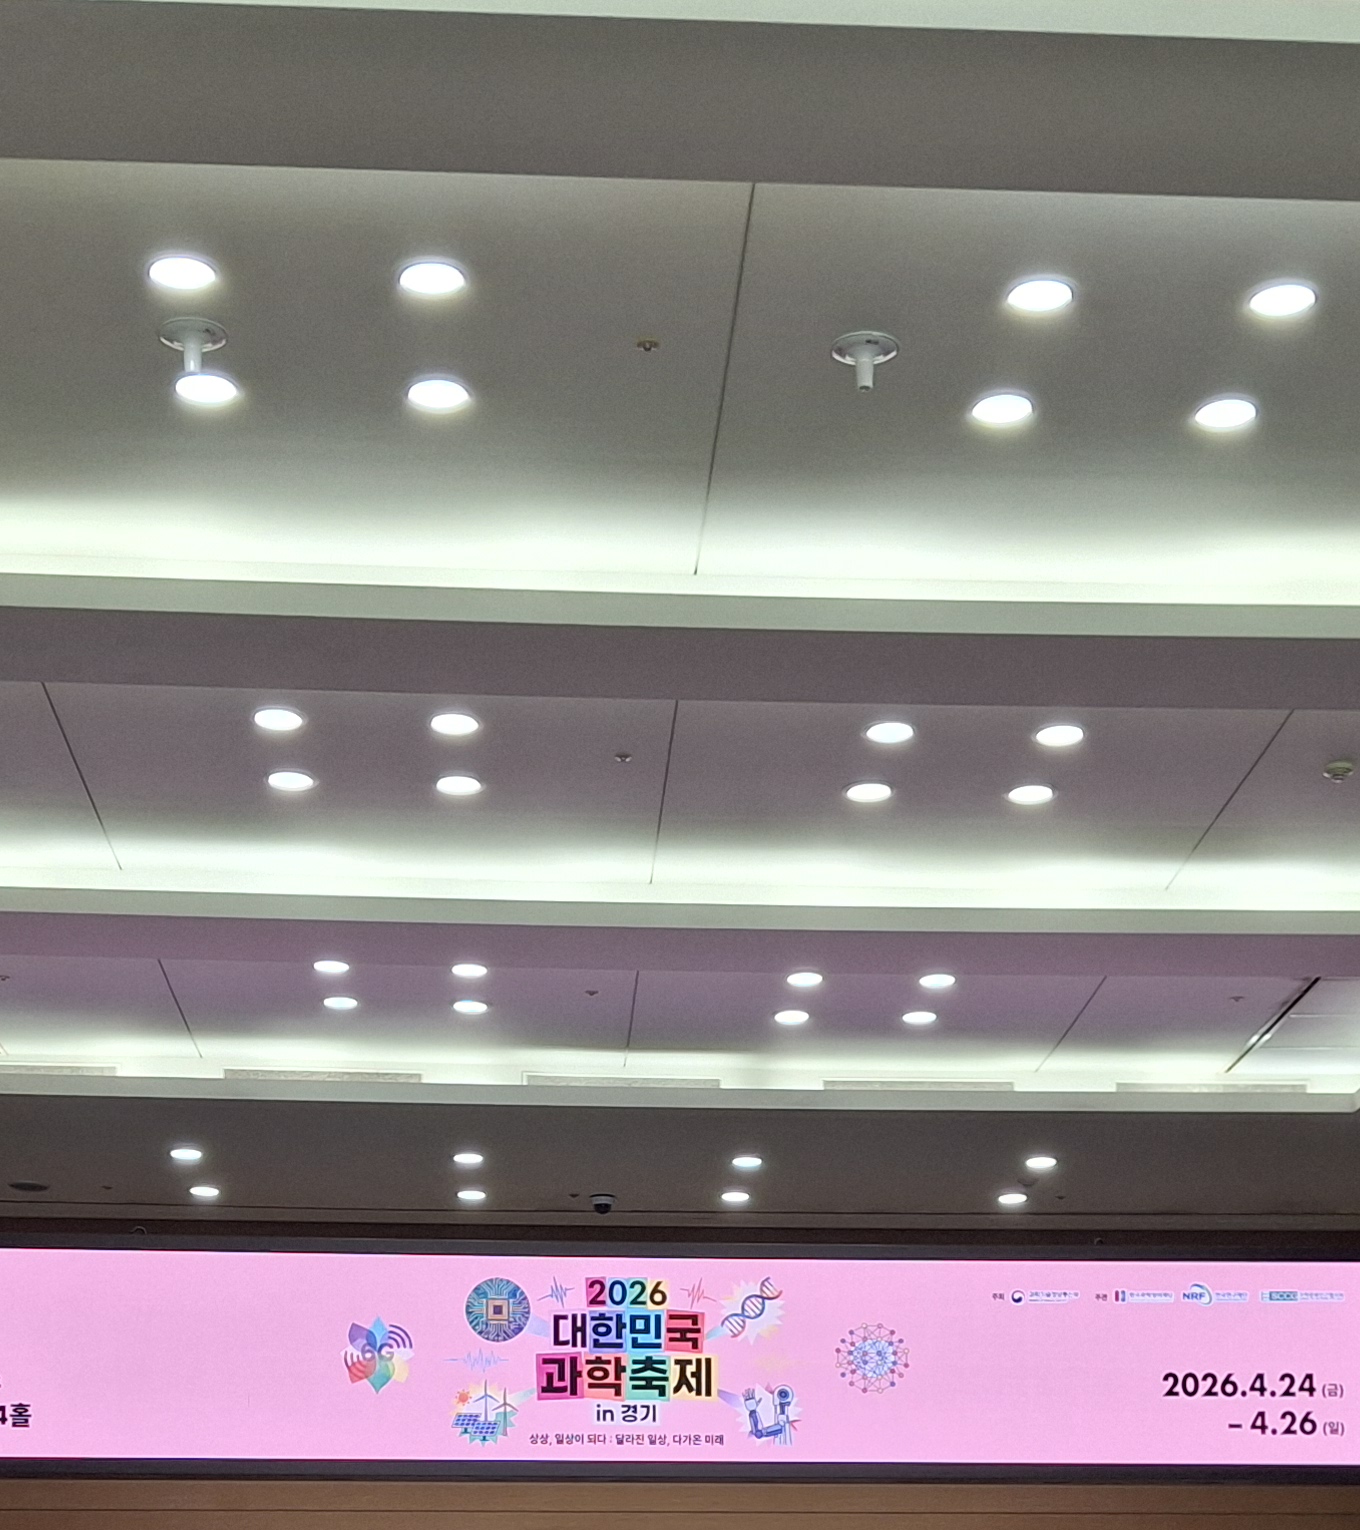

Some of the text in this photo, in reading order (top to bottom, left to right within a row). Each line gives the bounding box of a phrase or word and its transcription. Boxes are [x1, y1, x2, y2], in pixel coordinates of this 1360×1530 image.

[588, 1279, 668, 1306] 2026
[1182, 1292, 1207, 1301] NRF
[552, 1312, 702, 1350] 대한민국
[540, 1356, 713, 1398] 과학축제
[1162, 1372, 1344, 1399] 2026.4.24 (금)
[596, 1404, 657, 1422] in 경기
[1249, 1411, 1318, 1437] 4.26
[1322, 1421, 1346, 1438] (일)
[529, 1434, 553, 1447] 상상,
[555, 1433, 585, 1445] 일상이
[587, 1434, 606, 1445] 되다
[615, 1434, 645, 1446] 달라진
[647, 1434, 670, 1447] 일상,
[673, 1434, 702, 1446] 다가온
[705, 1434, 725, 1446] 미래
